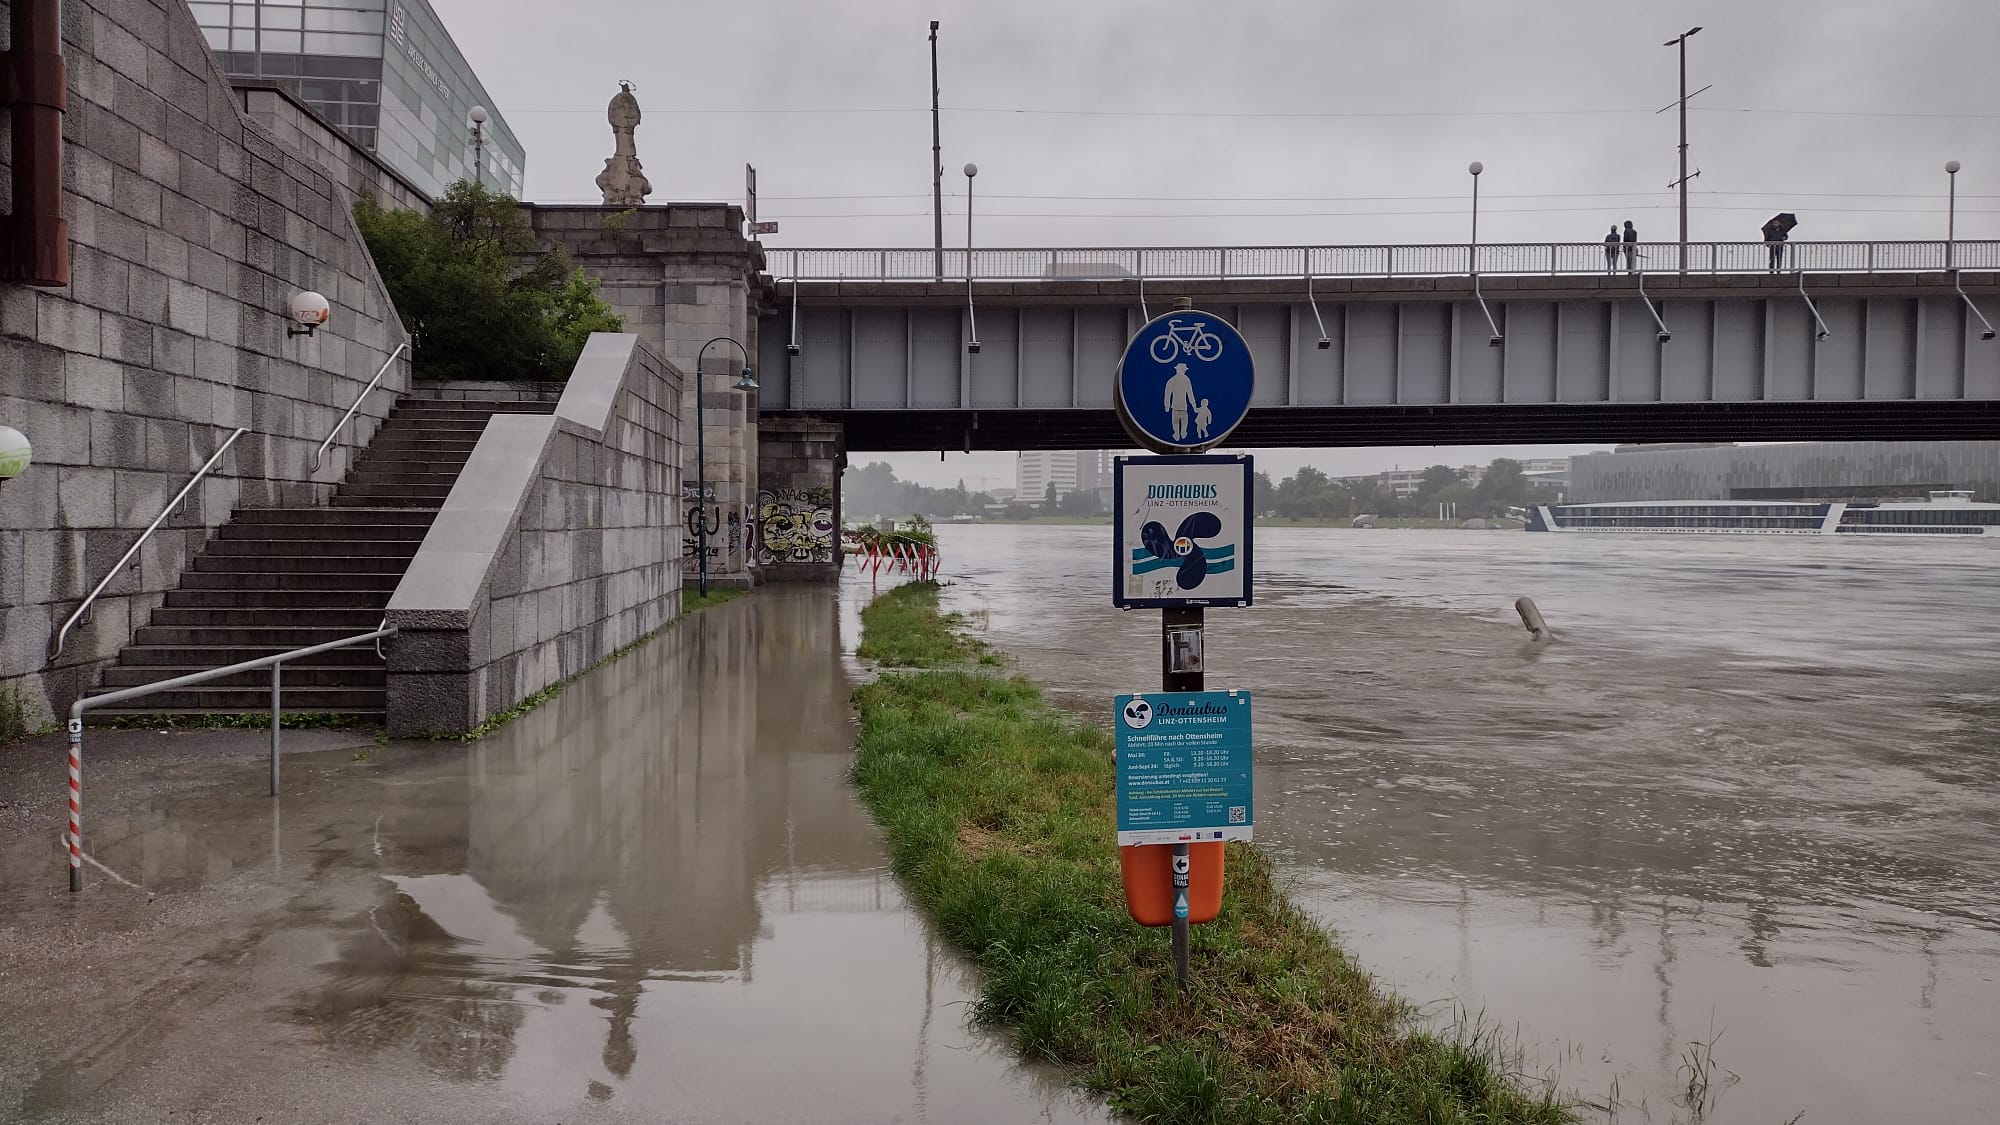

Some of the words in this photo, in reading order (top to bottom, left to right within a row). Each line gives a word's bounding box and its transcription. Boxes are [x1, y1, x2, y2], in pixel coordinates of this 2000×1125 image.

[1147, 484, 1217, 498] DONAUBUS
[1156, 701, 1228, 716] Donaubus
[1128, 734, 1168, 742] Schnellfähre
[1185, 732, 1223, 740] Ottensheim
